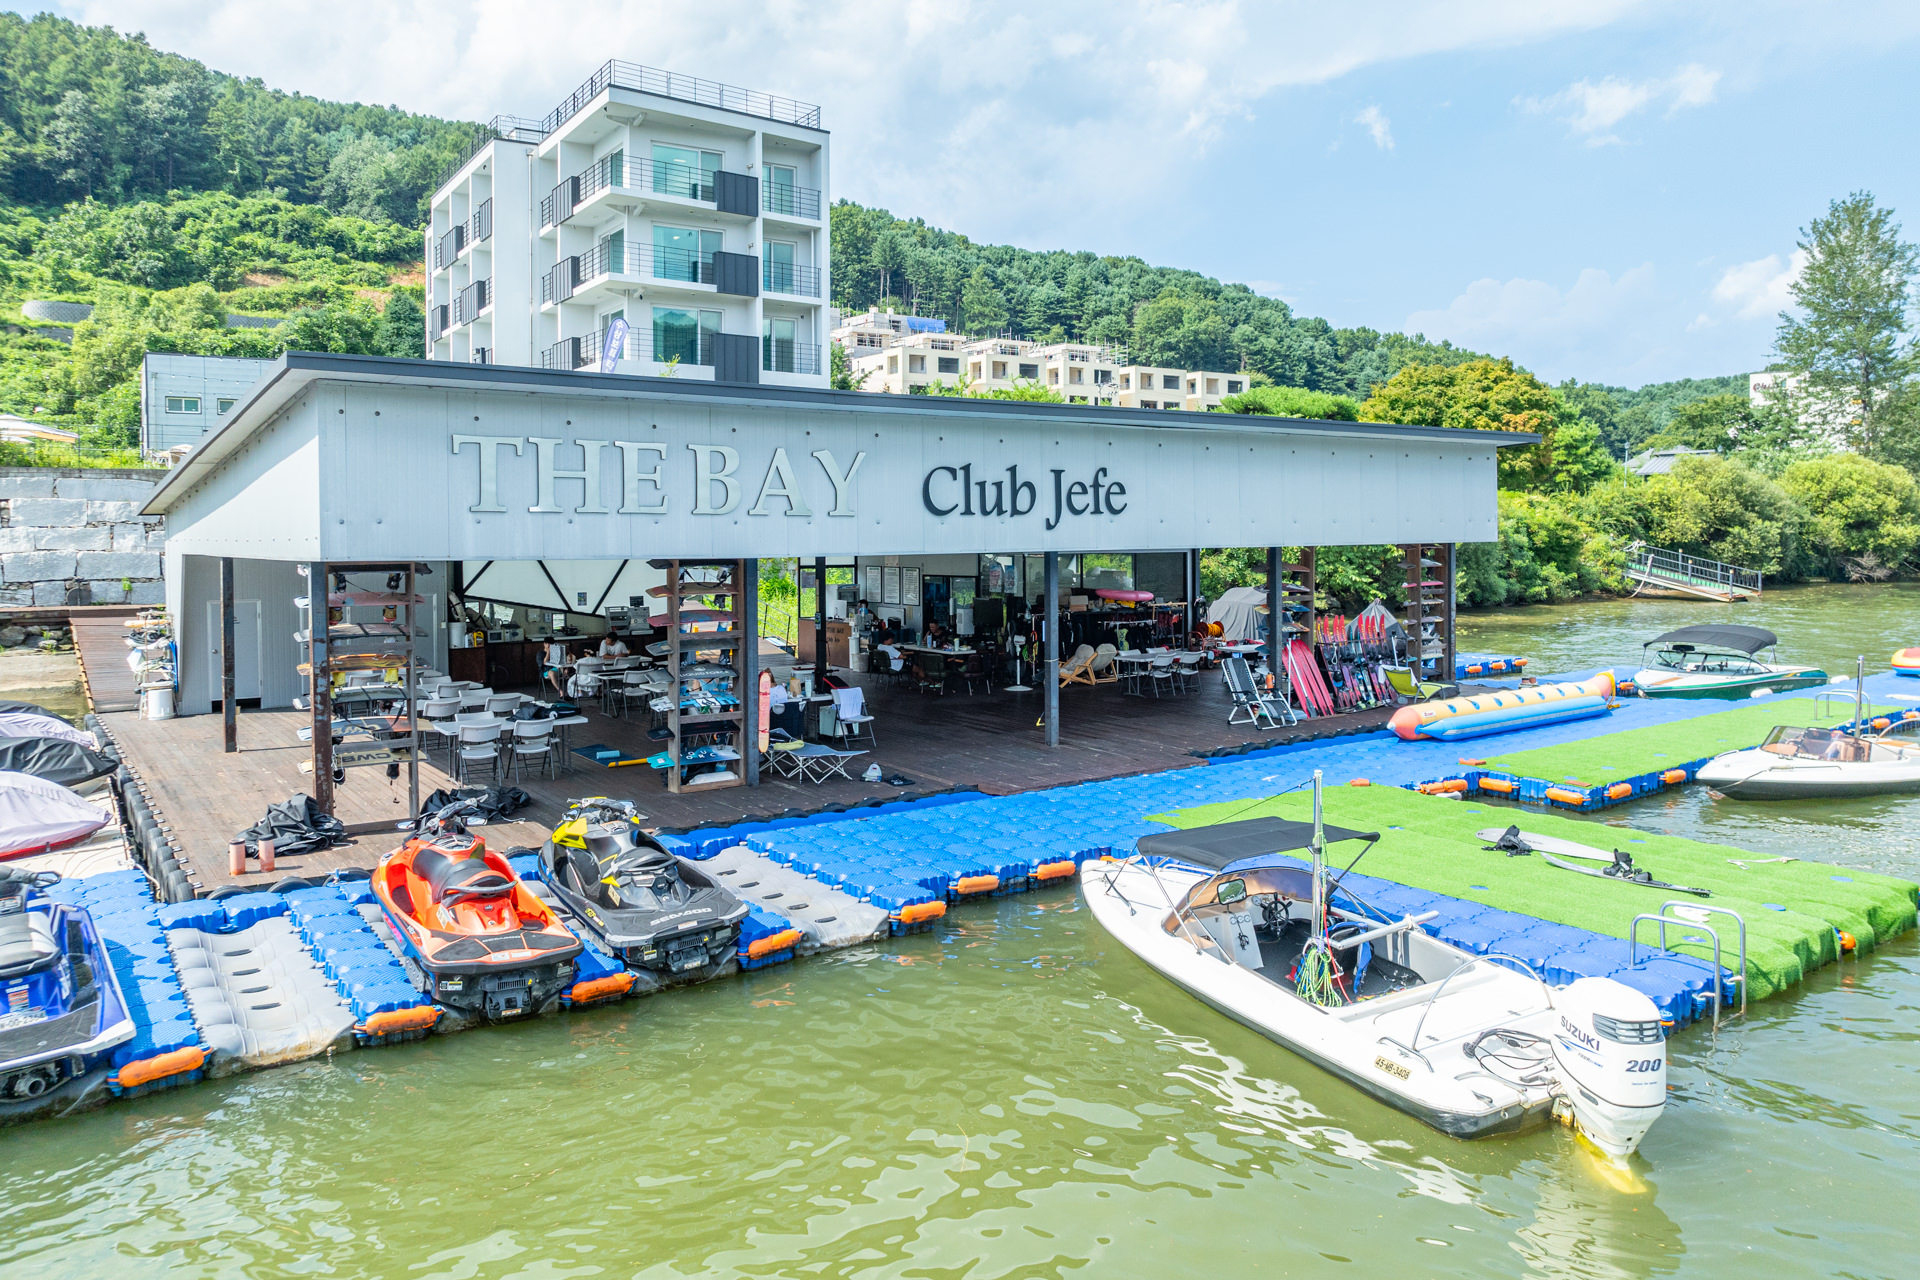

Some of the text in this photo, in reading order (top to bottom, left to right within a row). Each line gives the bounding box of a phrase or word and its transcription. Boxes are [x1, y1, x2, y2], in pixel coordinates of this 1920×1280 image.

[452, 434, 867, 517] THE BAY
[923, 463, 1127, 529] Club Jefe
[1560, 1015, 1600, 1051] SUZUKI
[1625, 1058, 1662, 1072] 200
